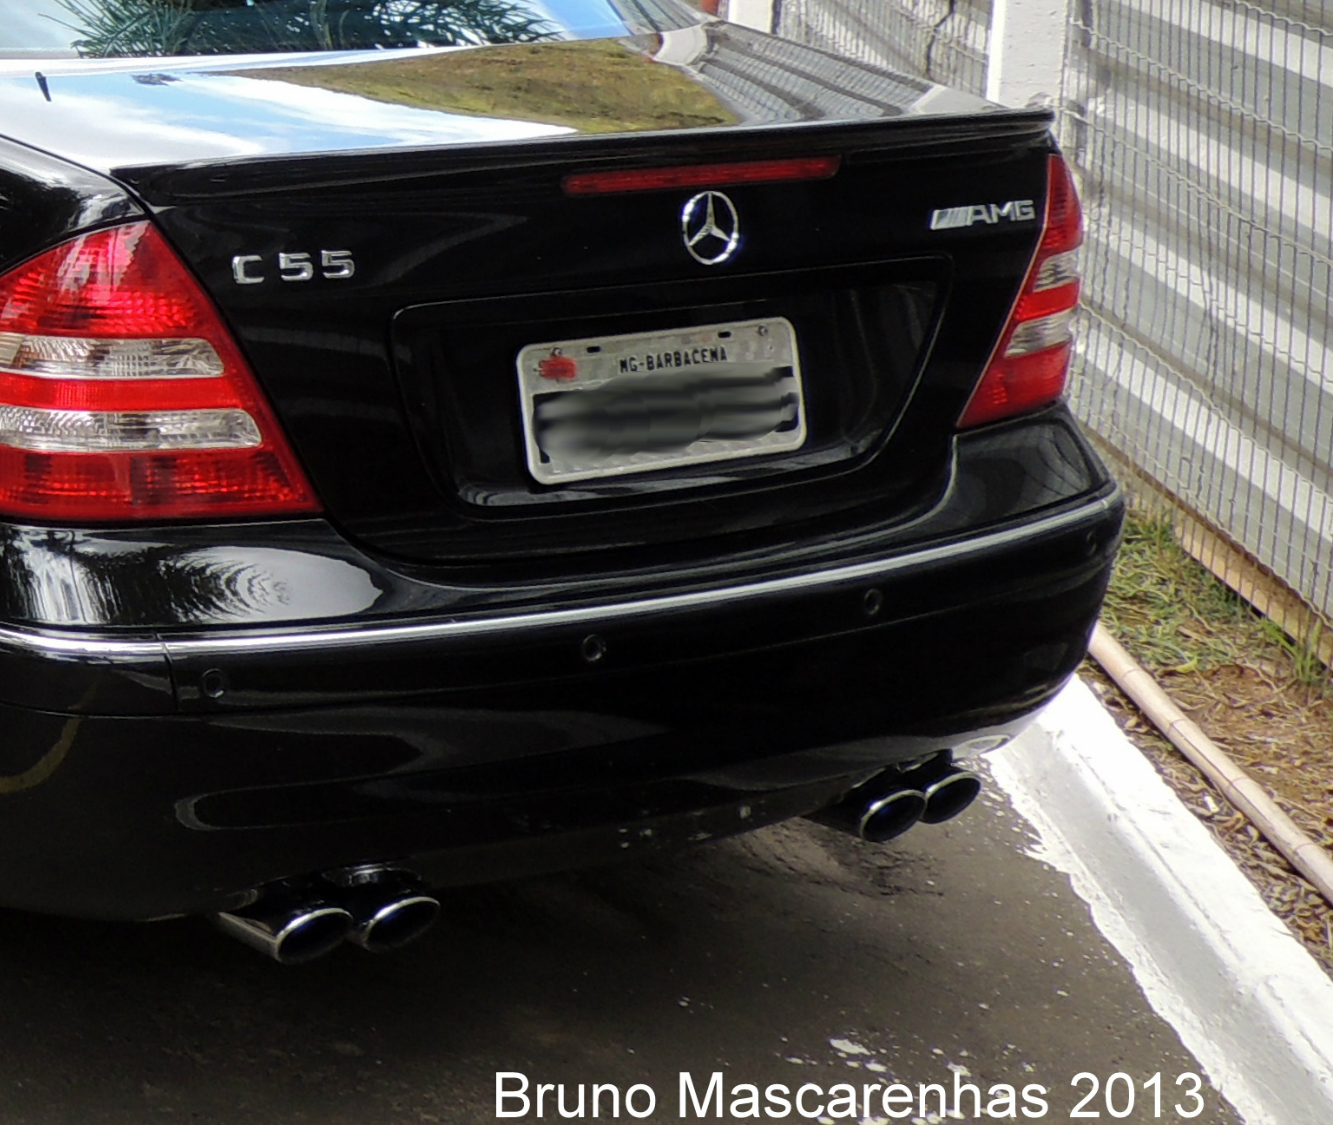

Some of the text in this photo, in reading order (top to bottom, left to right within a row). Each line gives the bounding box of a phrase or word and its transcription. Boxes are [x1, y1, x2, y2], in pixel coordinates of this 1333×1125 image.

[966, 199, 1036, 227] AMG
[232, 249, 355, 285] C 55
[619, 345, 728, 374] MG-BARBACENA
